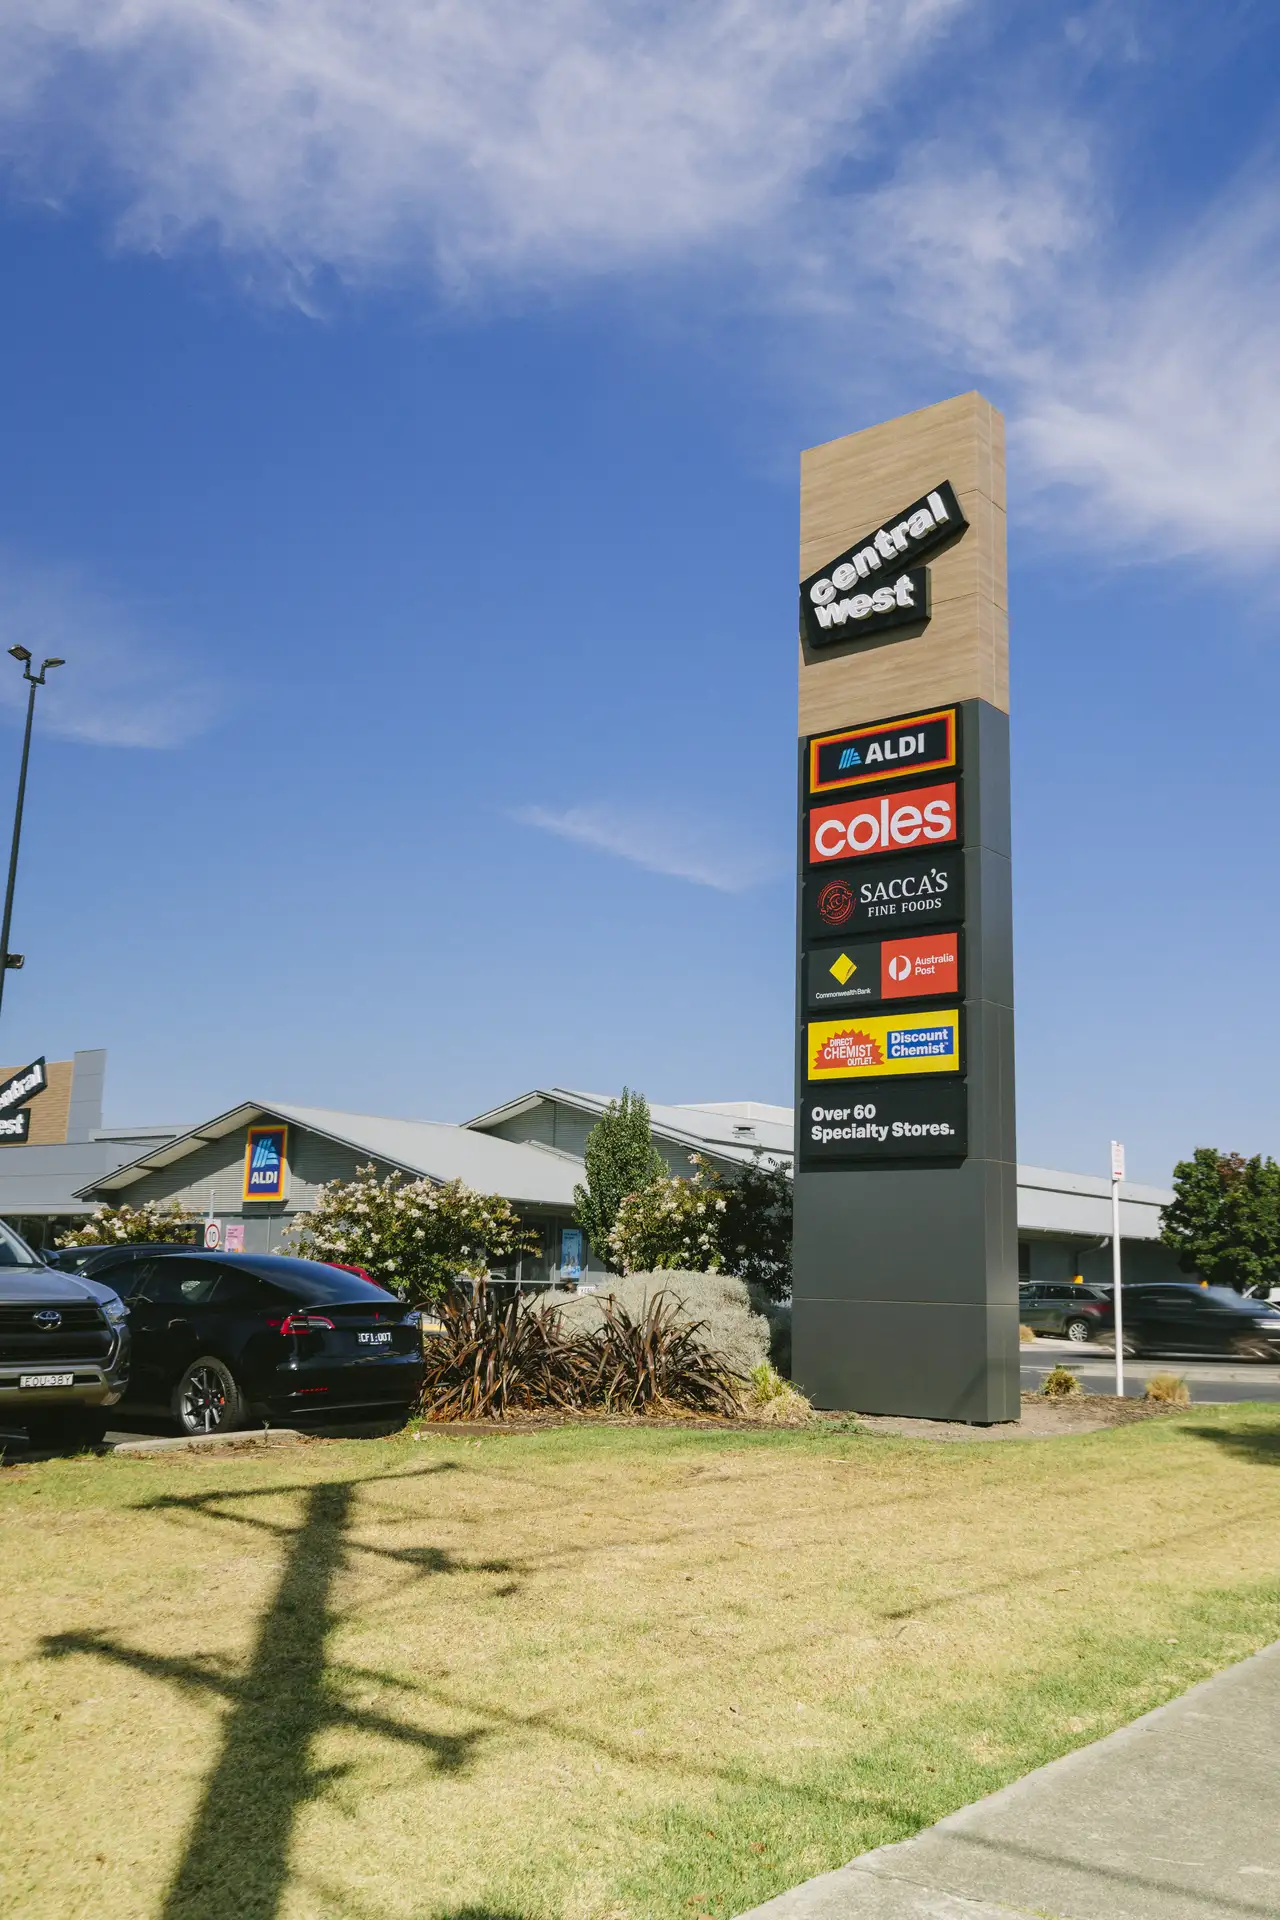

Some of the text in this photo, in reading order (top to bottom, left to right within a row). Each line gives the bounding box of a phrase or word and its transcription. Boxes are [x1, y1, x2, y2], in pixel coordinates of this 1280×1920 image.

[809, 491, 950, 605] central
[814, 574, 915, 629] west
[865, 732, 925, 764] ALDI
[814, 798, 951, 857] coles
[860, 868, 949, 903] SACCA'S
[868, 898, 942, 917] FINE FOODS
[914, 953, 954, 965] Australia
[914, 965, 935, 976] Post
[829, 1037, 854, 1047] DIRECT
[891, 1029, 948, 1044] Discount
[823, 1044, 873, 1060] CHEMIST
[811, 1104, 876, 1122] Over 60
[811, 1121, 955, 1143] Specialty Stores.
[251, 1171, 278, 1184] ALDI
[209, 1231, 216, 1242] 10
